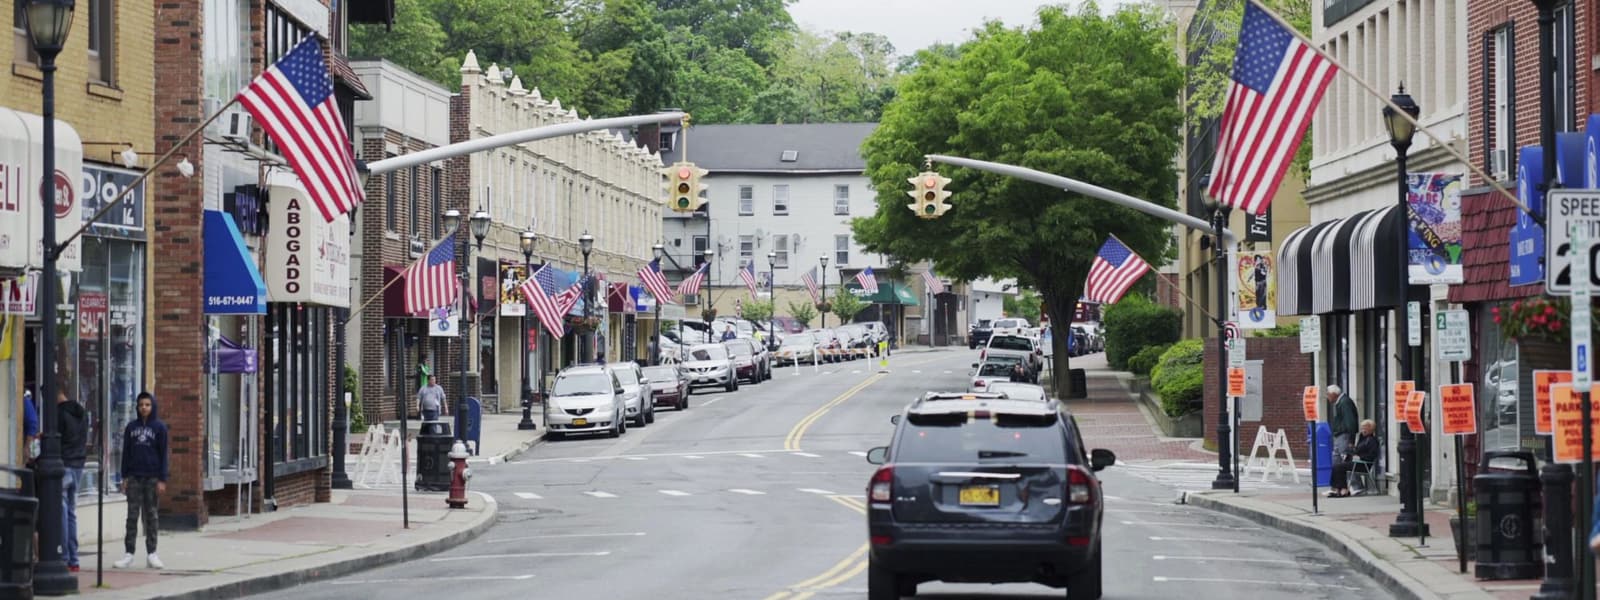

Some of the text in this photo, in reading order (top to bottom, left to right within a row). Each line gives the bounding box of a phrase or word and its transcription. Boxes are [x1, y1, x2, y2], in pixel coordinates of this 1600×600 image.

[286, 198, 301, 294] ABOGADO
[1438, 315, 1446, 329] 2
[1443, 395, 1470, 403] PARKING
